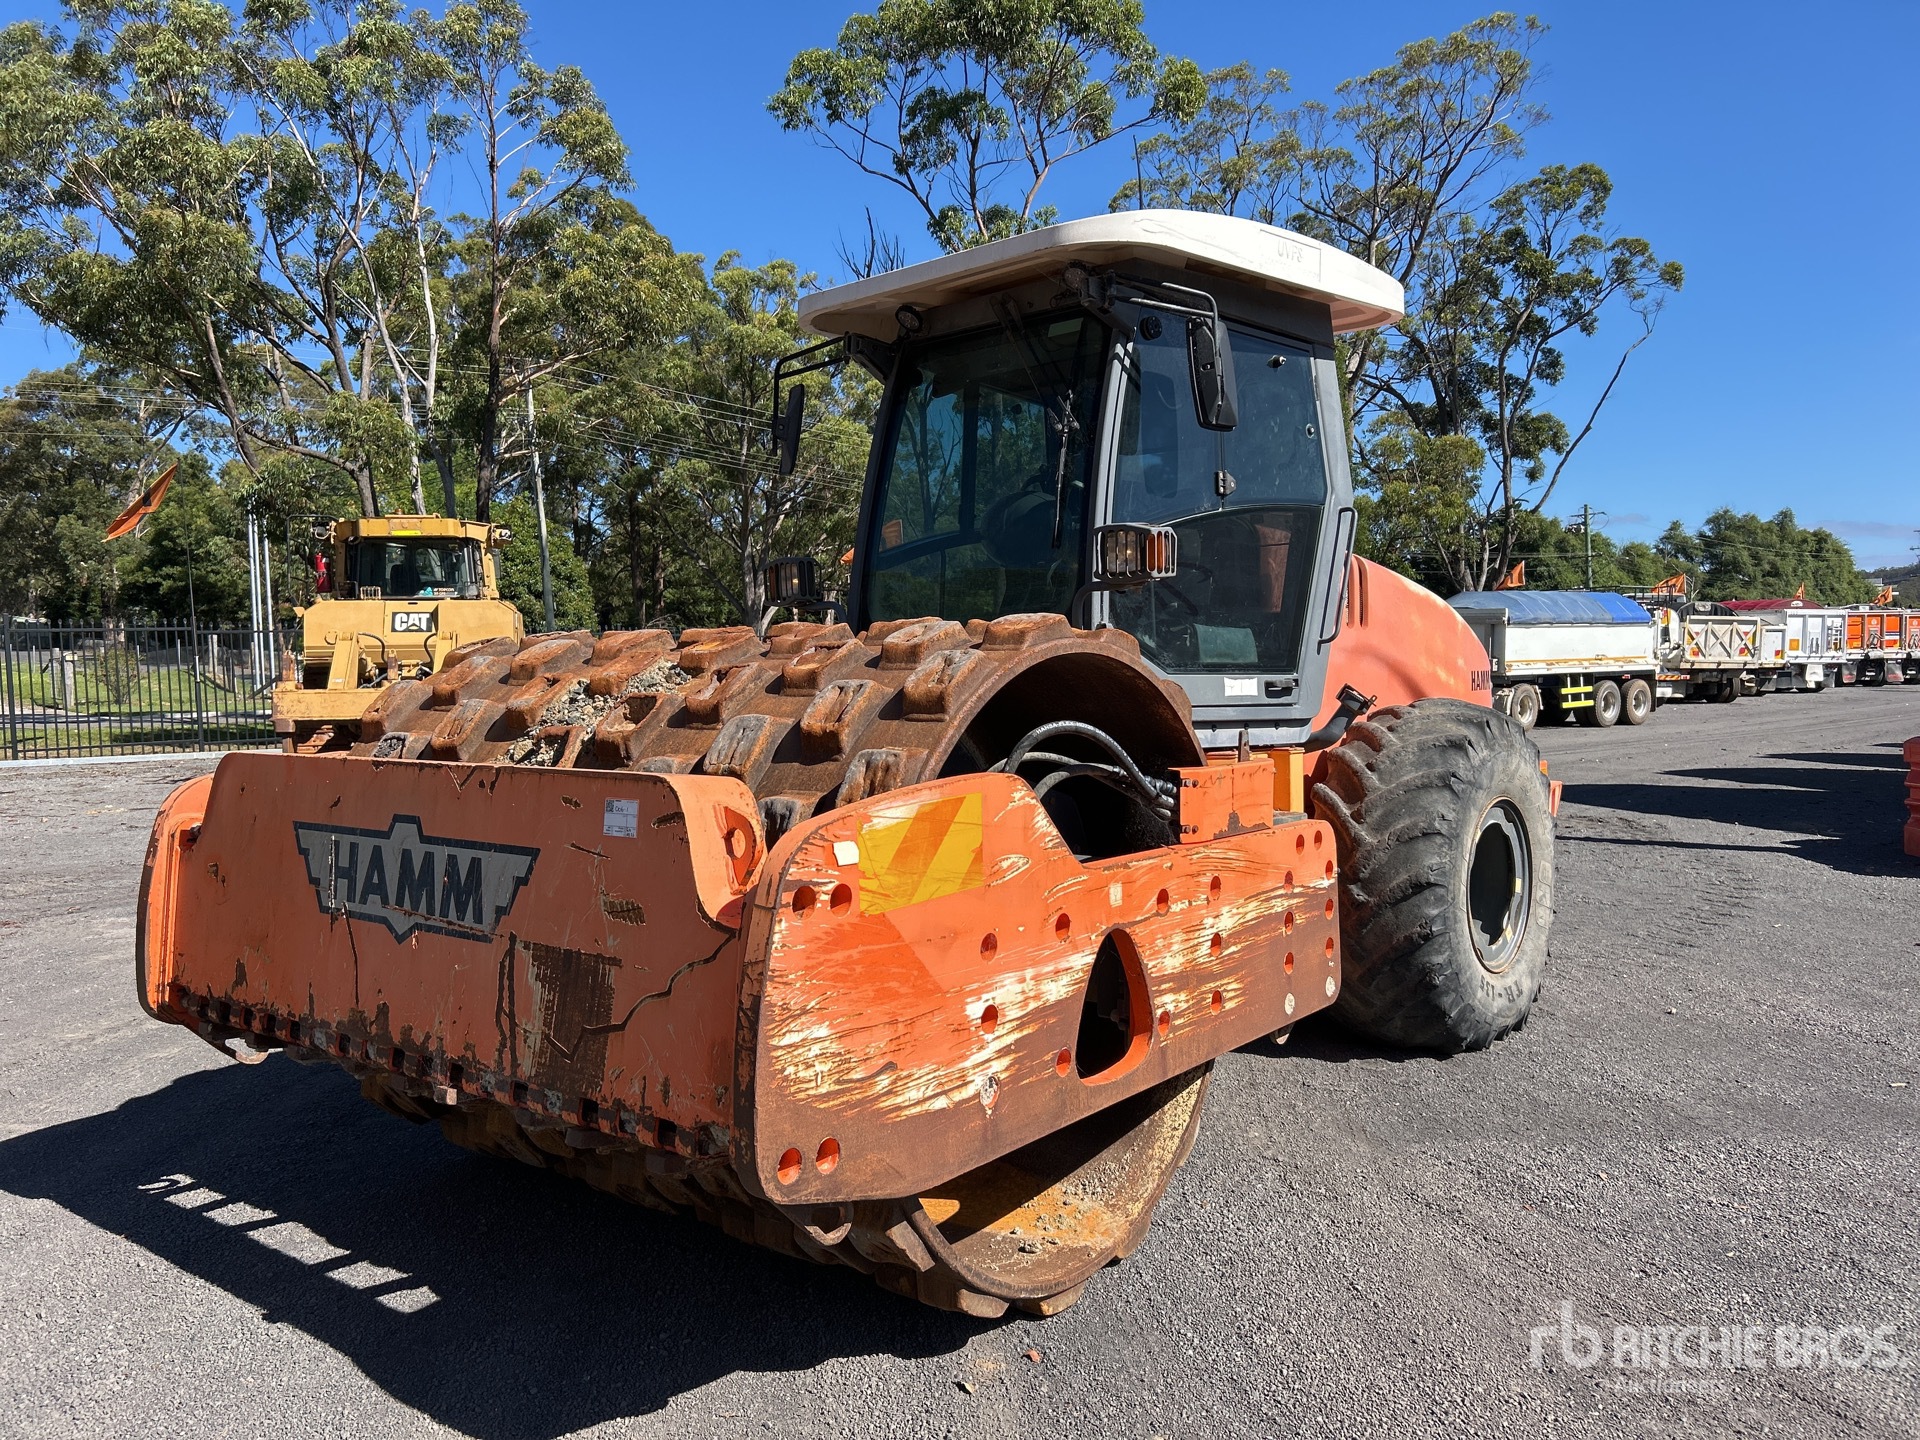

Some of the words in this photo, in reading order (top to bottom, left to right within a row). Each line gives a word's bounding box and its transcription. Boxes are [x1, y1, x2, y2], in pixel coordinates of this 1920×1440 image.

[395, 613, 430, 631] CAT
[1471, 670, 1491, 692] HAMM
[328, 836, 484, 925] HAMM
